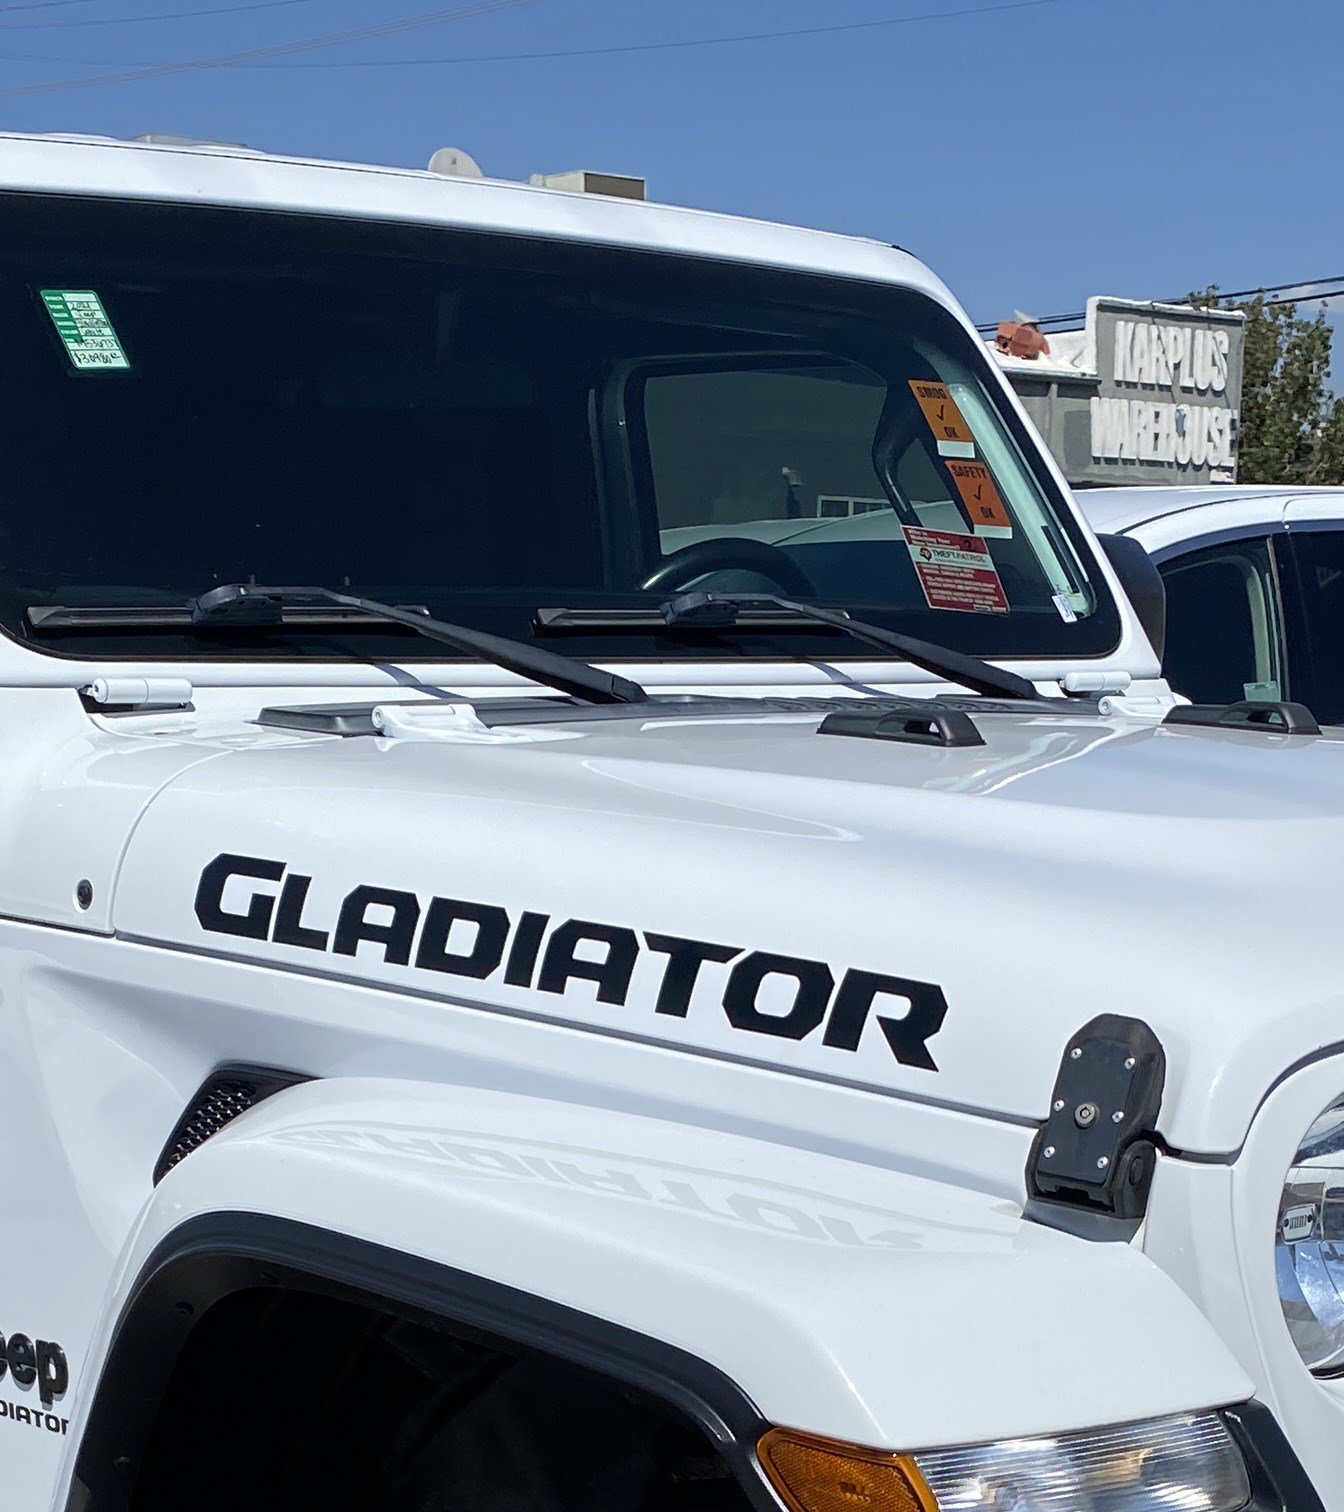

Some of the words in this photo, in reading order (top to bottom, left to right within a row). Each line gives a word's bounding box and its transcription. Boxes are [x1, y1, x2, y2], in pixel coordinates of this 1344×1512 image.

[1114, 321, 1229, 391] KARPLUS
[915, 386, 947, 400] SMOG
[944, 426, 960, 438] OK
[1090, 397, 1237, 466] WAREHOUSE
[950, 465, 988, 479] SAFETY
[980, 506, 996, 519] OK
[194, 853, 949, 1071] GLADIATOR
